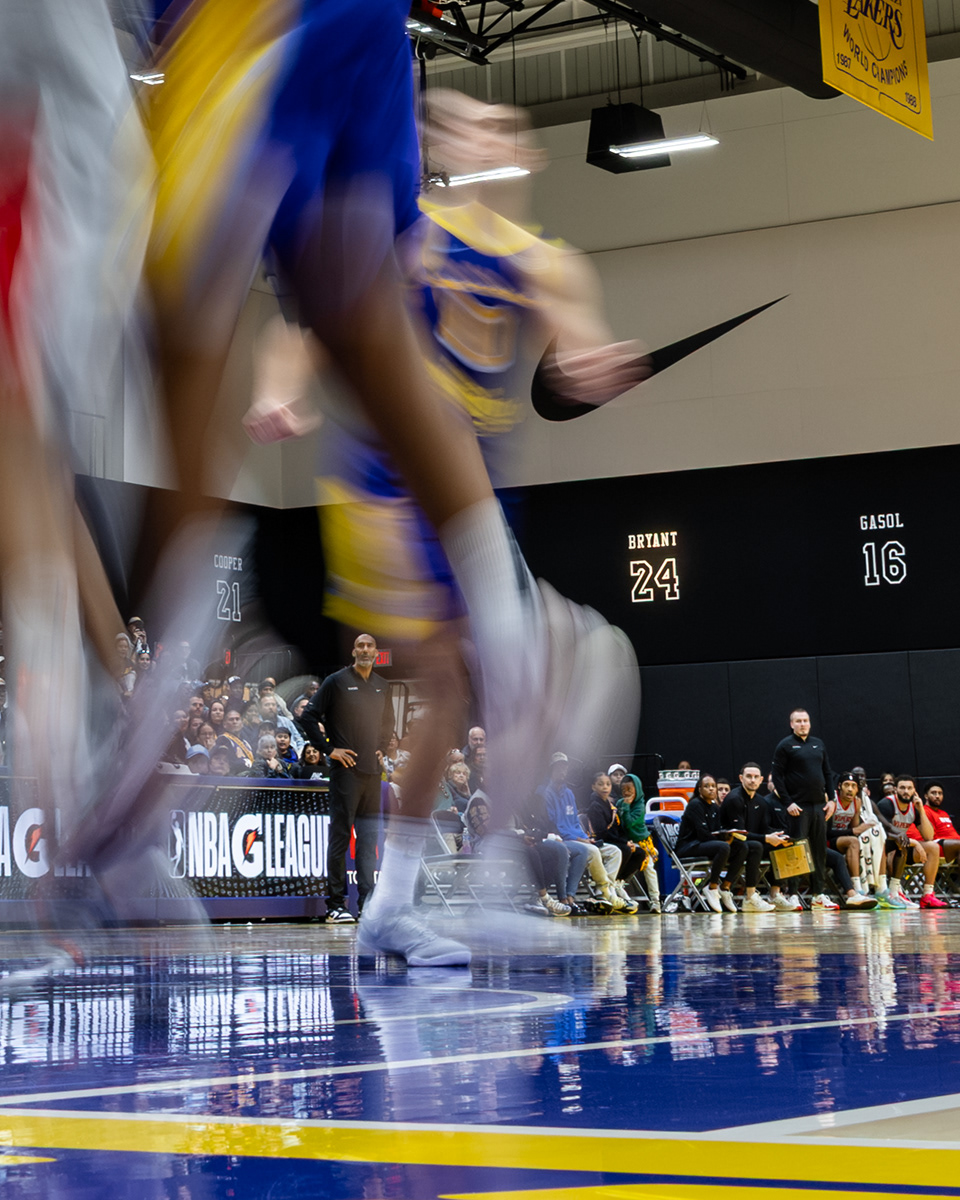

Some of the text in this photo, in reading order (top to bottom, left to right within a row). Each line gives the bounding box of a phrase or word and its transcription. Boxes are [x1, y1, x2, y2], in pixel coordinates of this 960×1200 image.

[836, 52, 851, 69] 1987
[843, 23, 869, 71] WORLD
[628, 531, 678, 549] BRYANT
[860, 513, 904, 530] GASOL
[214, 554, 243, 571] COOPER
[630, 558, 679, 602] 24
[862, 540, 907, 586] 16
[216, 580, 241, 621] 21
[189, 812, 232, 877] NBA
[232, 813, 264, 878] G
